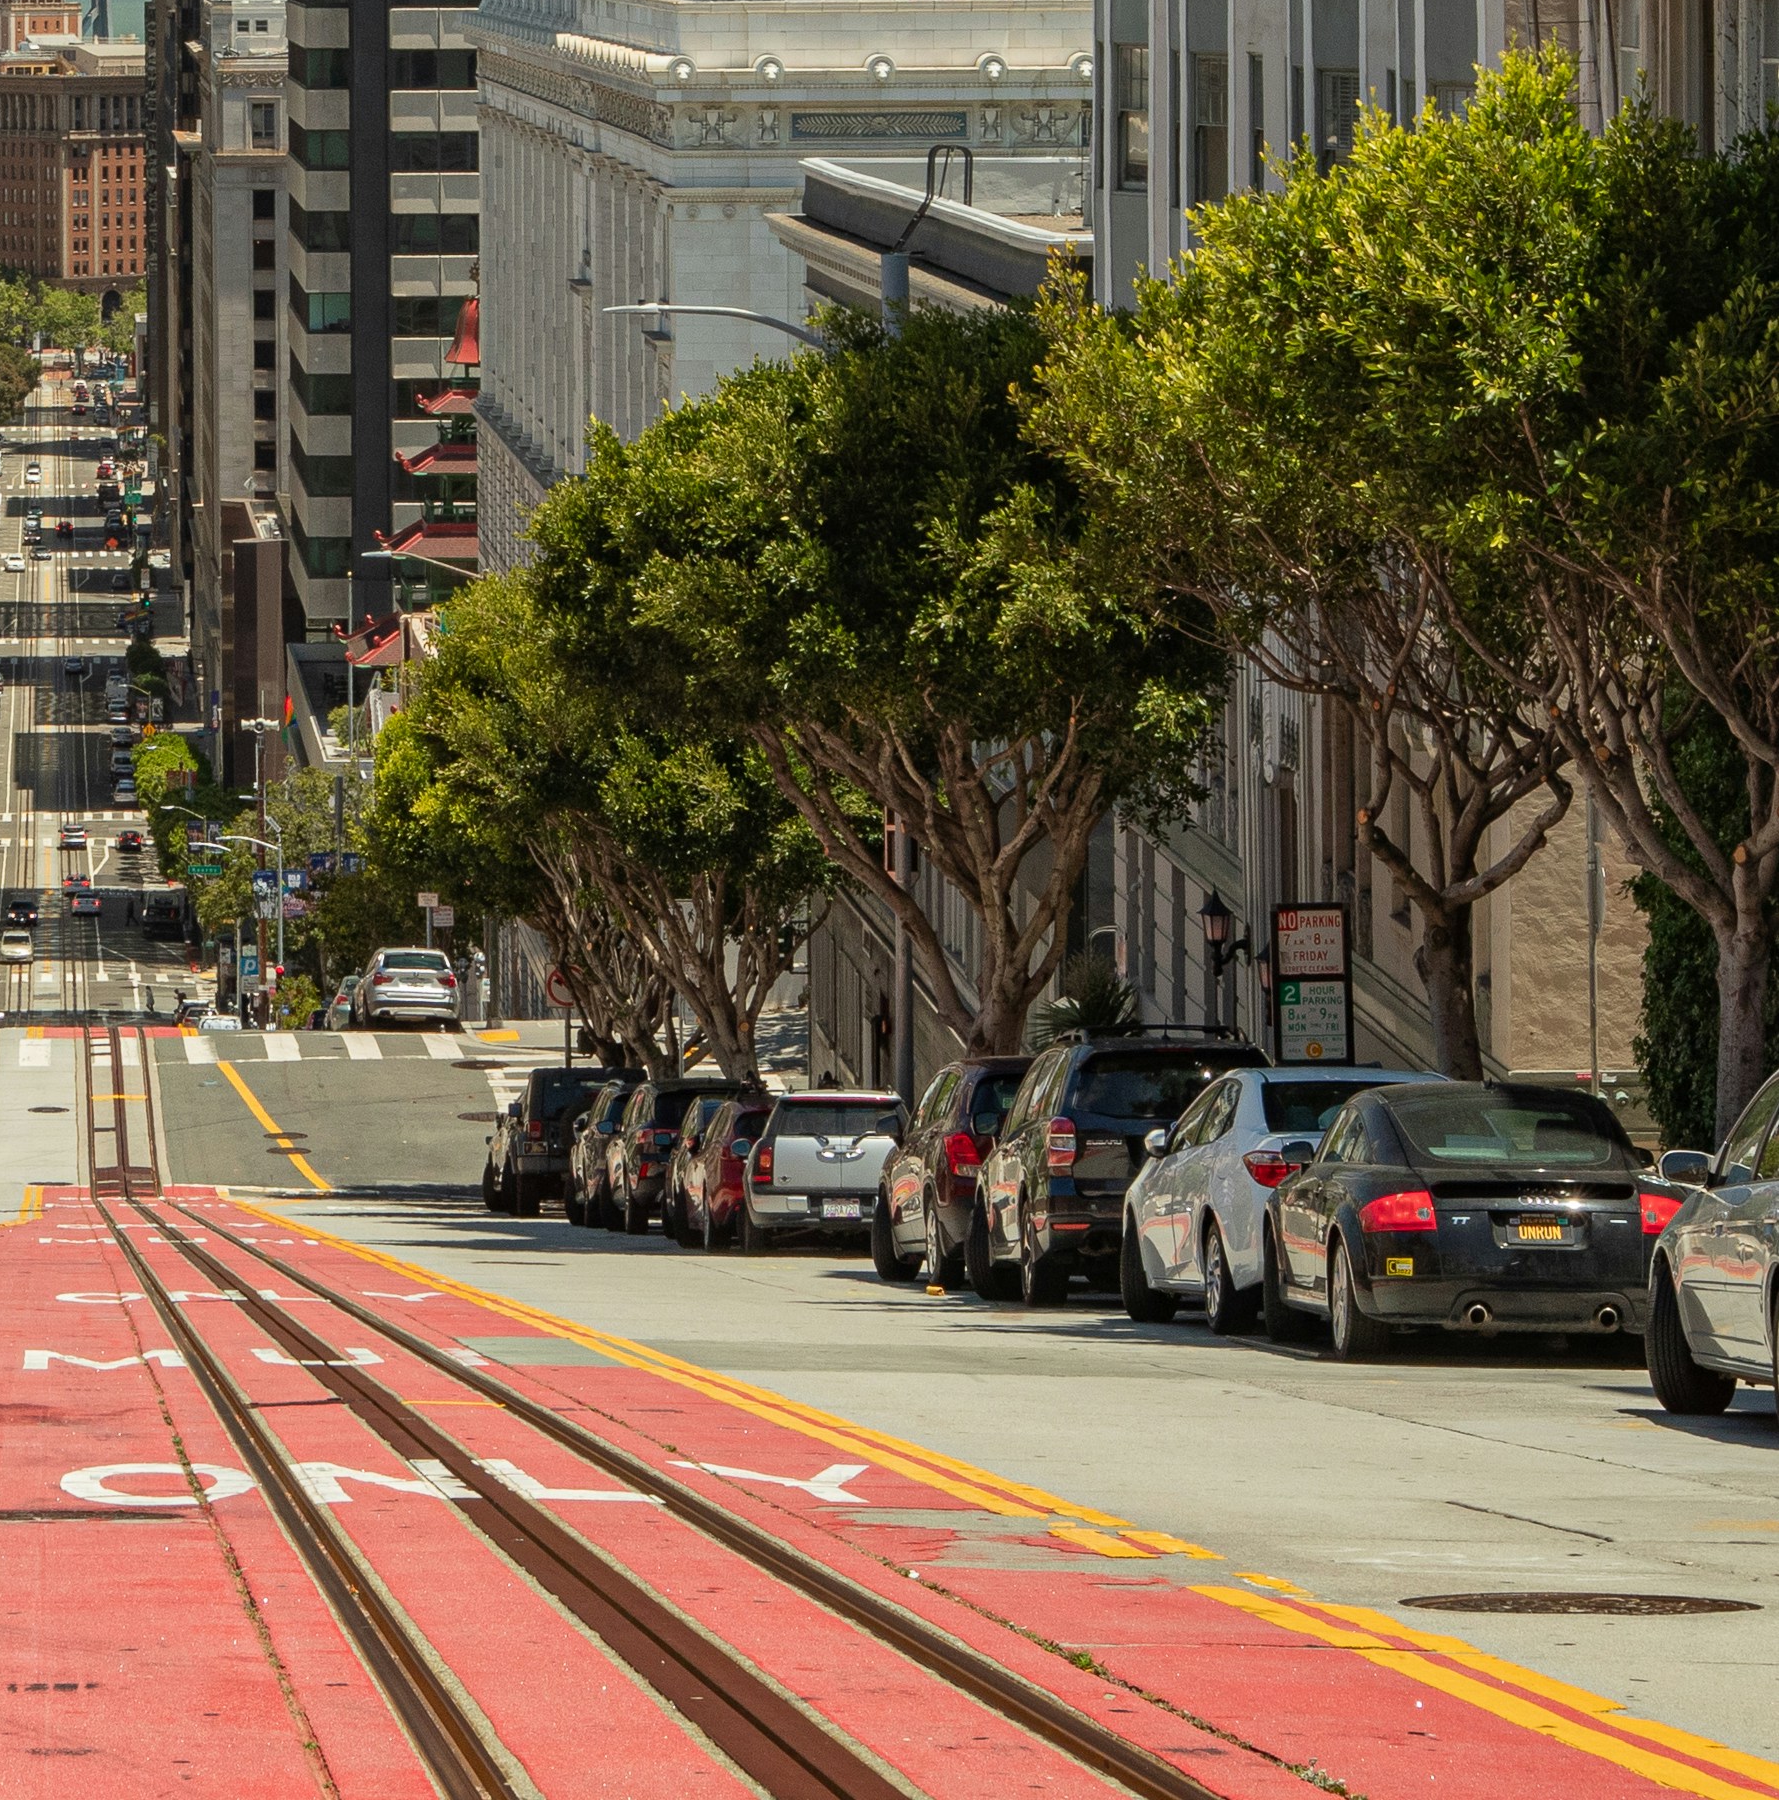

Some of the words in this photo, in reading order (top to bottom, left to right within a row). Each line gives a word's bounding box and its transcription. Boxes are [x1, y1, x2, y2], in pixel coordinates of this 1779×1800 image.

[1278, 911, 1296, 929] NO
[1299, 915, 1341, 929] PARKING
[1283, 933, 1291, 946] 7
[1313, 932, 1321, 945] 8
[1293, 950, 1329, 961] FRIDAY
[1284, 985, 1296, 1002] 2
[1309, 985, 1335, 995] HOUR
[1302, 996, 1343, 1005] PARKING
[1288, 1008, 1295, 1020] 8
[1319, 1007, 1327, 1020] 9
[1288, 1023, 1306, 1032] MON
[1326, 1022, 1340, 1031] FRI
[1309, 1043, 1319, 1056] C
[1451, 1216, 1470, 1225] TT
[1518, 1225, 1562, 1240] UNRUN
[55, 1289, 446, 1304] ONLY
[61, 1458, 871, 1506] ONLY
